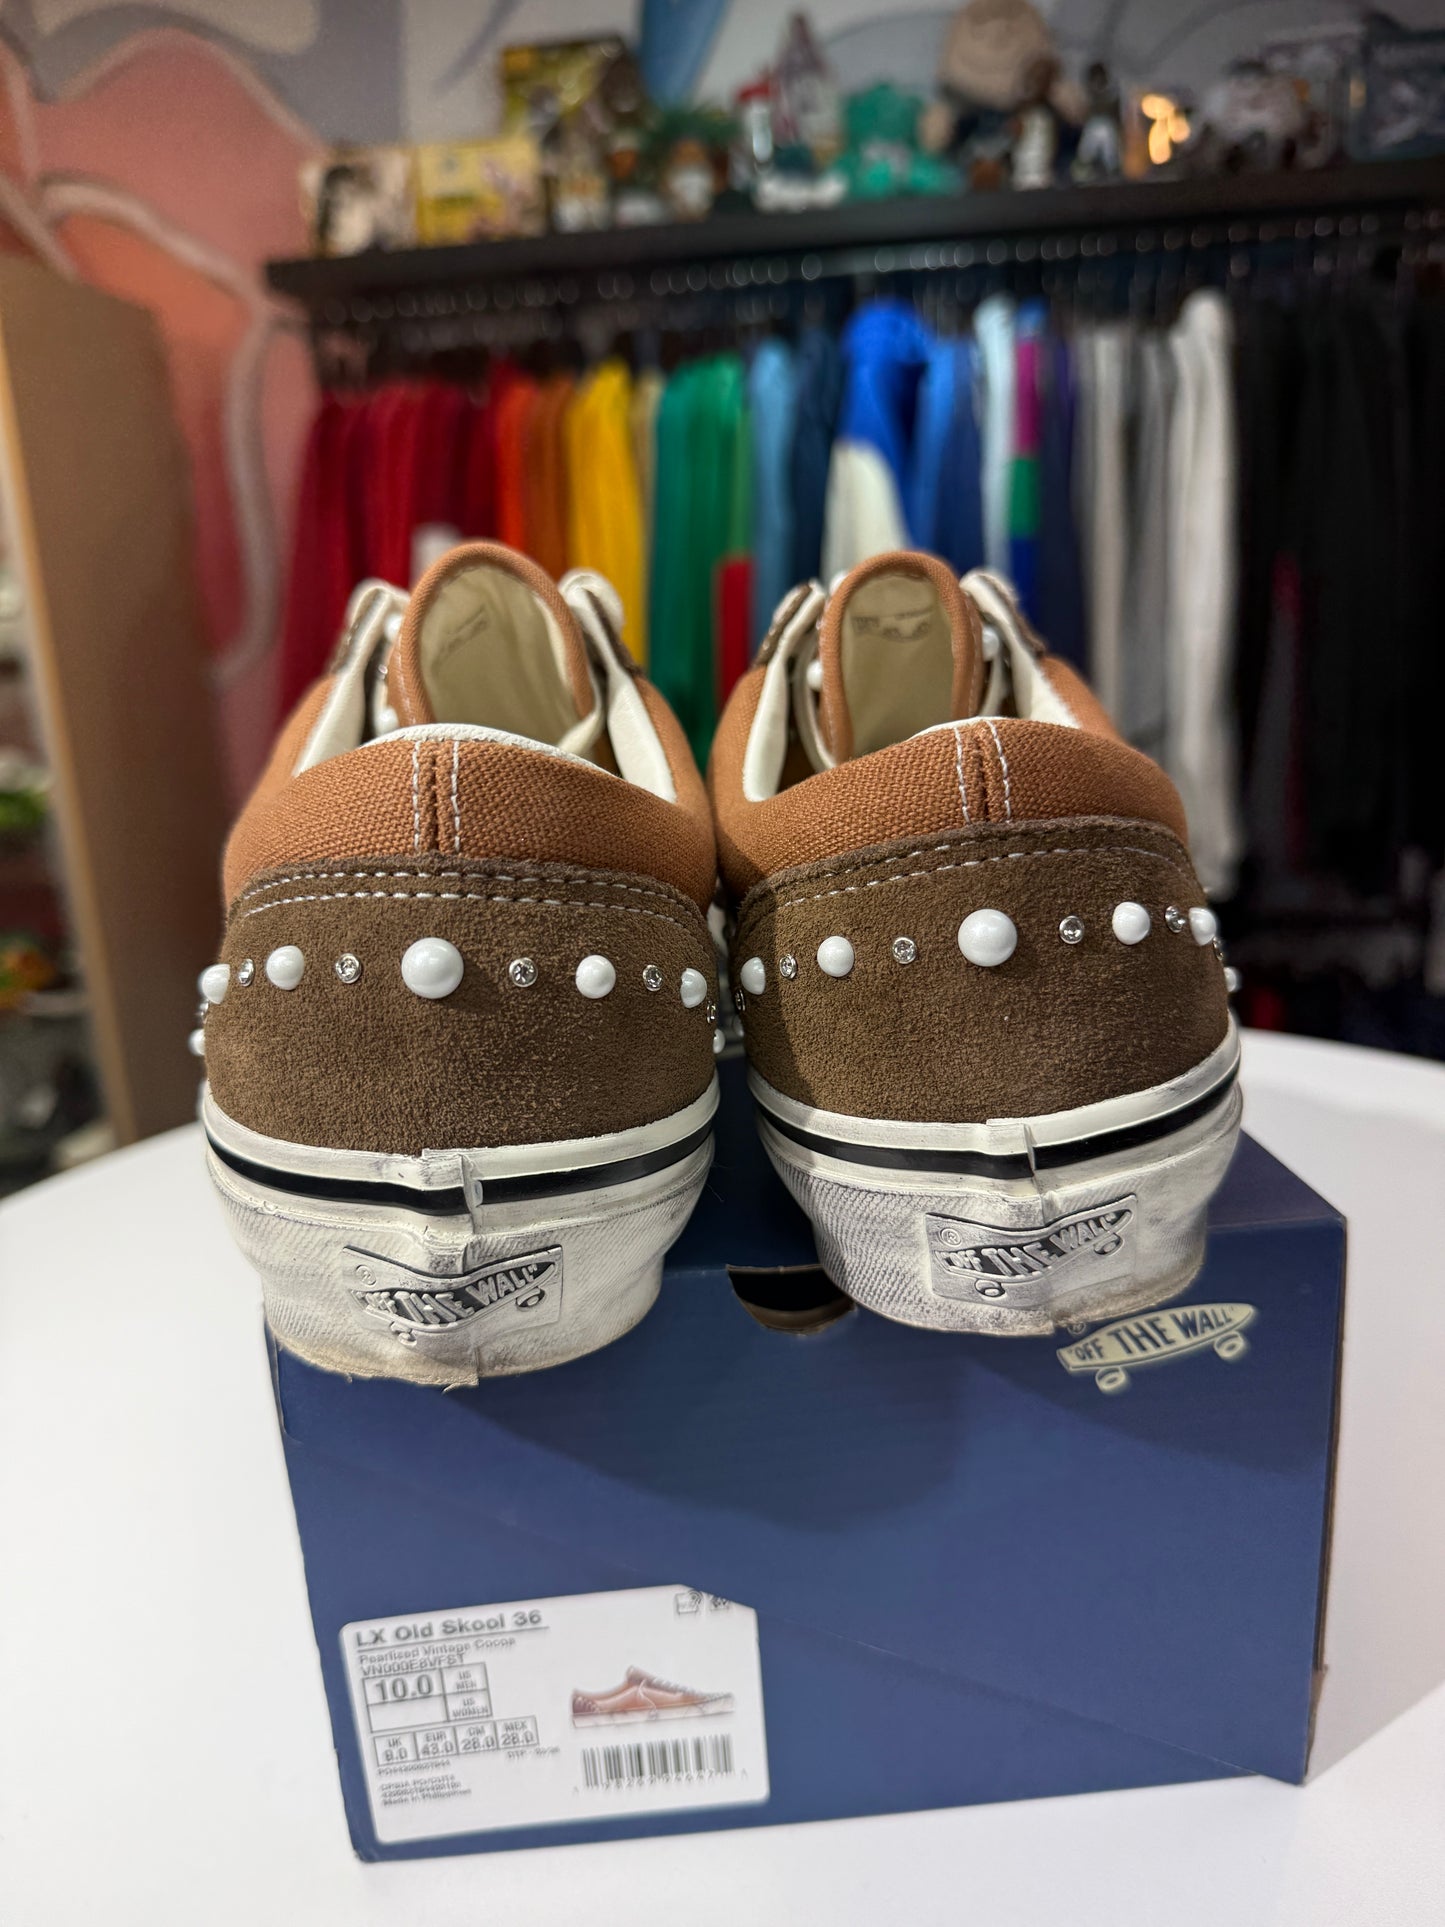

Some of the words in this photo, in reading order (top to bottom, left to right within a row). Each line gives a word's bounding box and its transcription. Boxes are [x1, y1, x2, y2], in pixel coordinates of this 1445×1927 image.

[981, 1241, 1055, 1277] THE
[394, 1290, 475, 1325] THE
[1107, 1315, 1176, 1355] THE
[355, 1627, 386, 1648] LX
[394, 1621, 434, 1642] Old
[441, 1613, 506, 1636] Skool
[511, 1609, 543, 1628] 36
[375, 1673, 434, 1701] 10.0
[455, 1680, 478, 1691] MEN
[452, 1706, 489, 1718] WOMEN
[503, 1719, 528, 1733] MEX
[425, 1730, 447, 1743] EUR
[461, 1734, 496, 1752] 28.0
[500, 1730, 535, 1748] 28.0
[421, 1740, 454, 1756] 43.0
